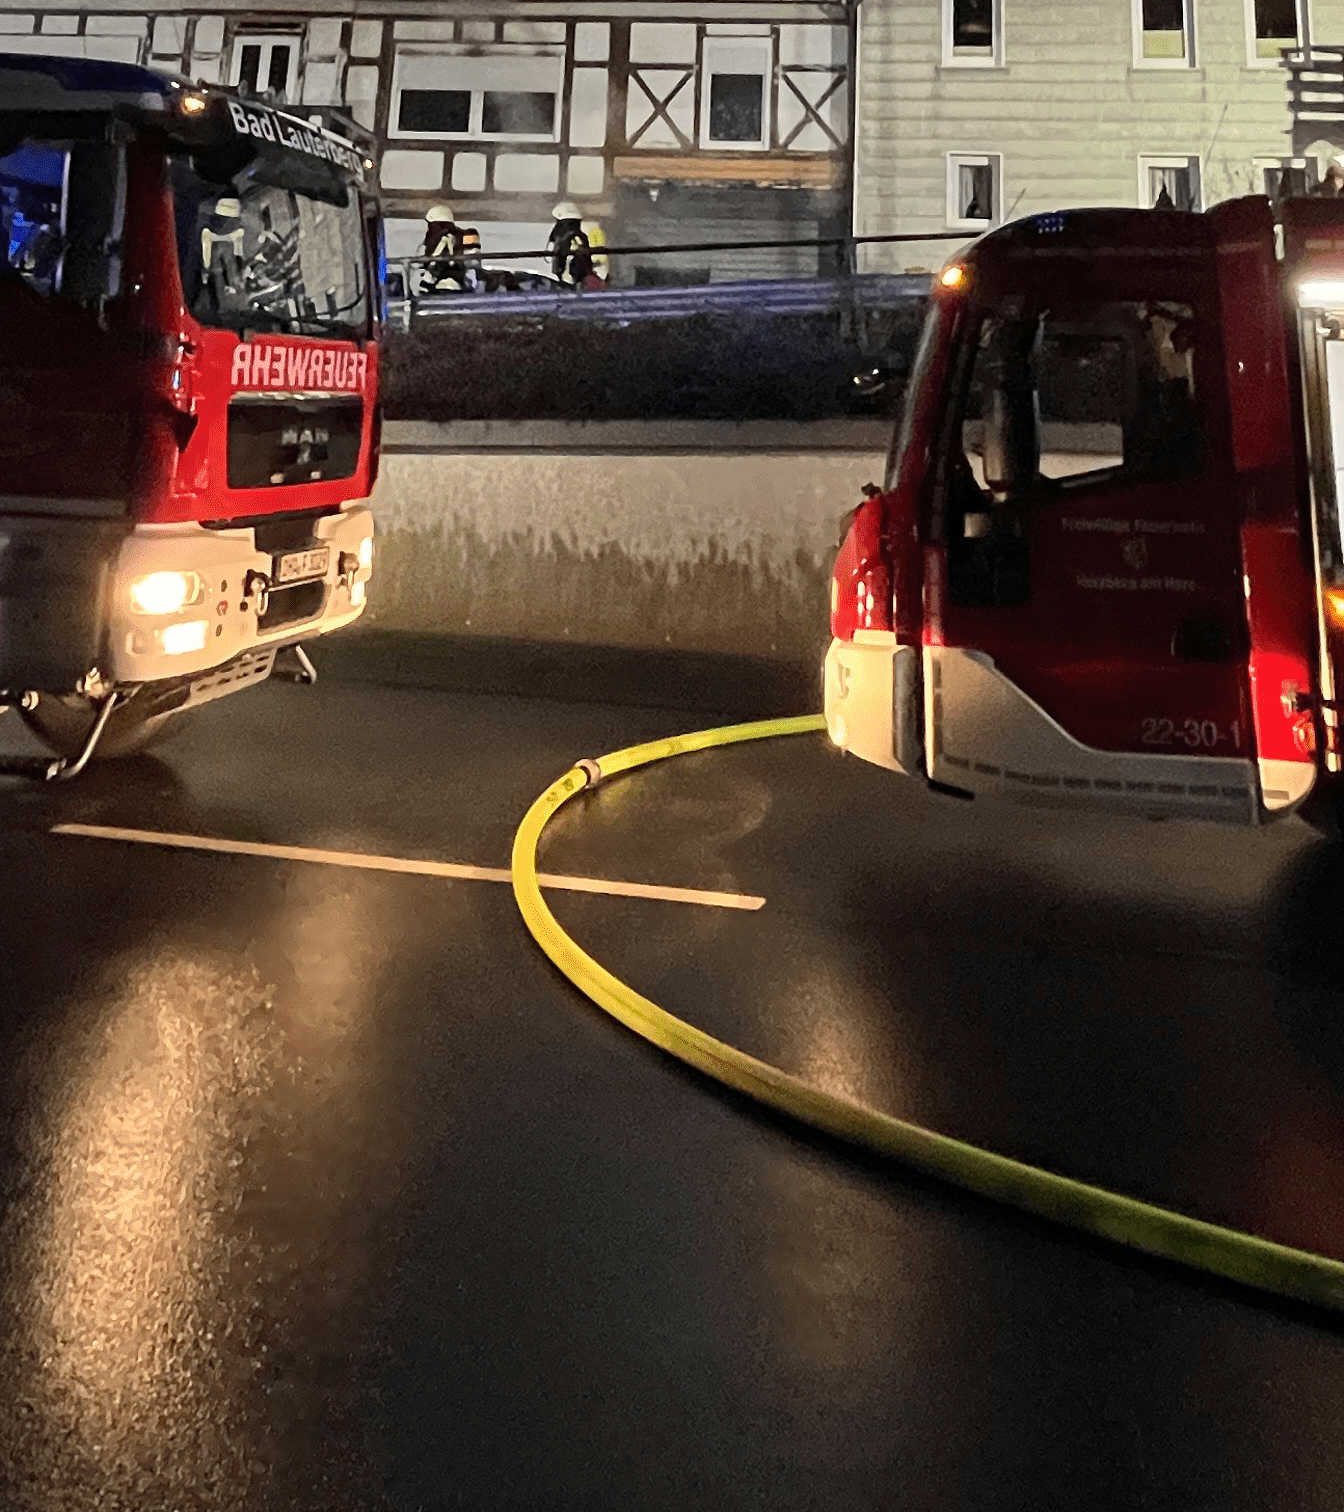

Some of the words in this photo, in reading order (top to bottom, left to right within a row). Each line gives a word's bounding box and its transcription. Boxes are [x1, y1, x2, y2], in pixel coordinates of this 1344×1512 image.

[228, 101, 277, 143] Bad
[271, 114, 366, 184] Lauterberg
[1142, 718, 1241, 750] 22-30-1
